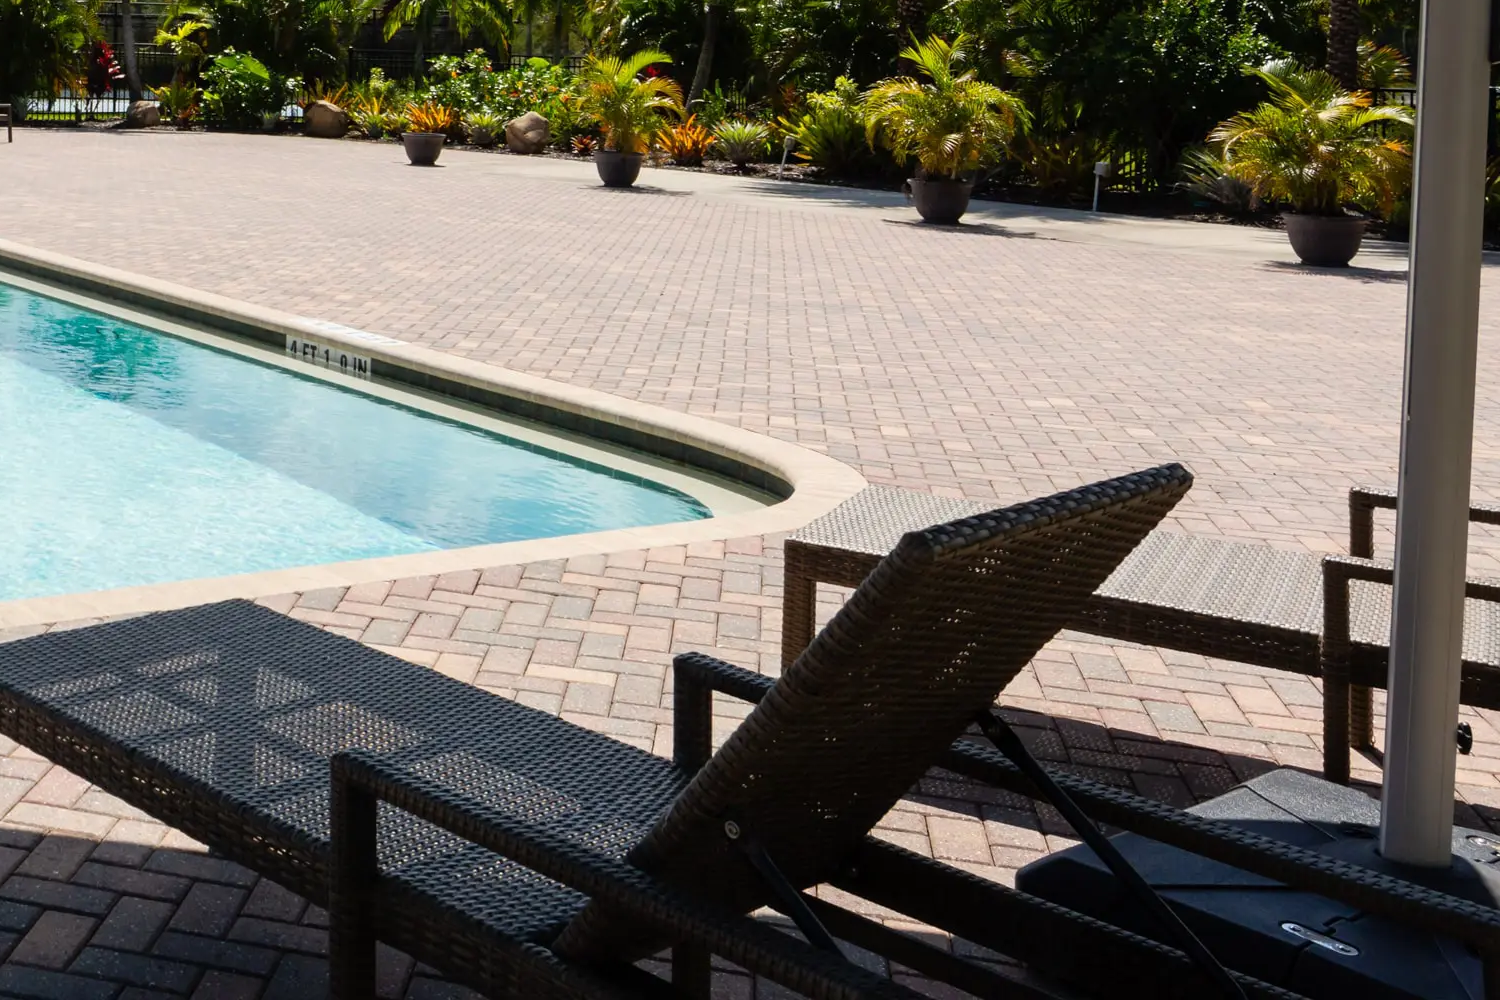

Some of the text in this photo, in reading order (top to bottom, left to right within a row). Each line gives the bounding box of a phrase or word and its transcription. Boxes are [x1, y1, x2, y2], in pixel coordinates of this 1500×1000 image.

[290, 340, 297, 354] 4
[303, 343, 317, 358] FT
[353, 357, 367, 374] IN
